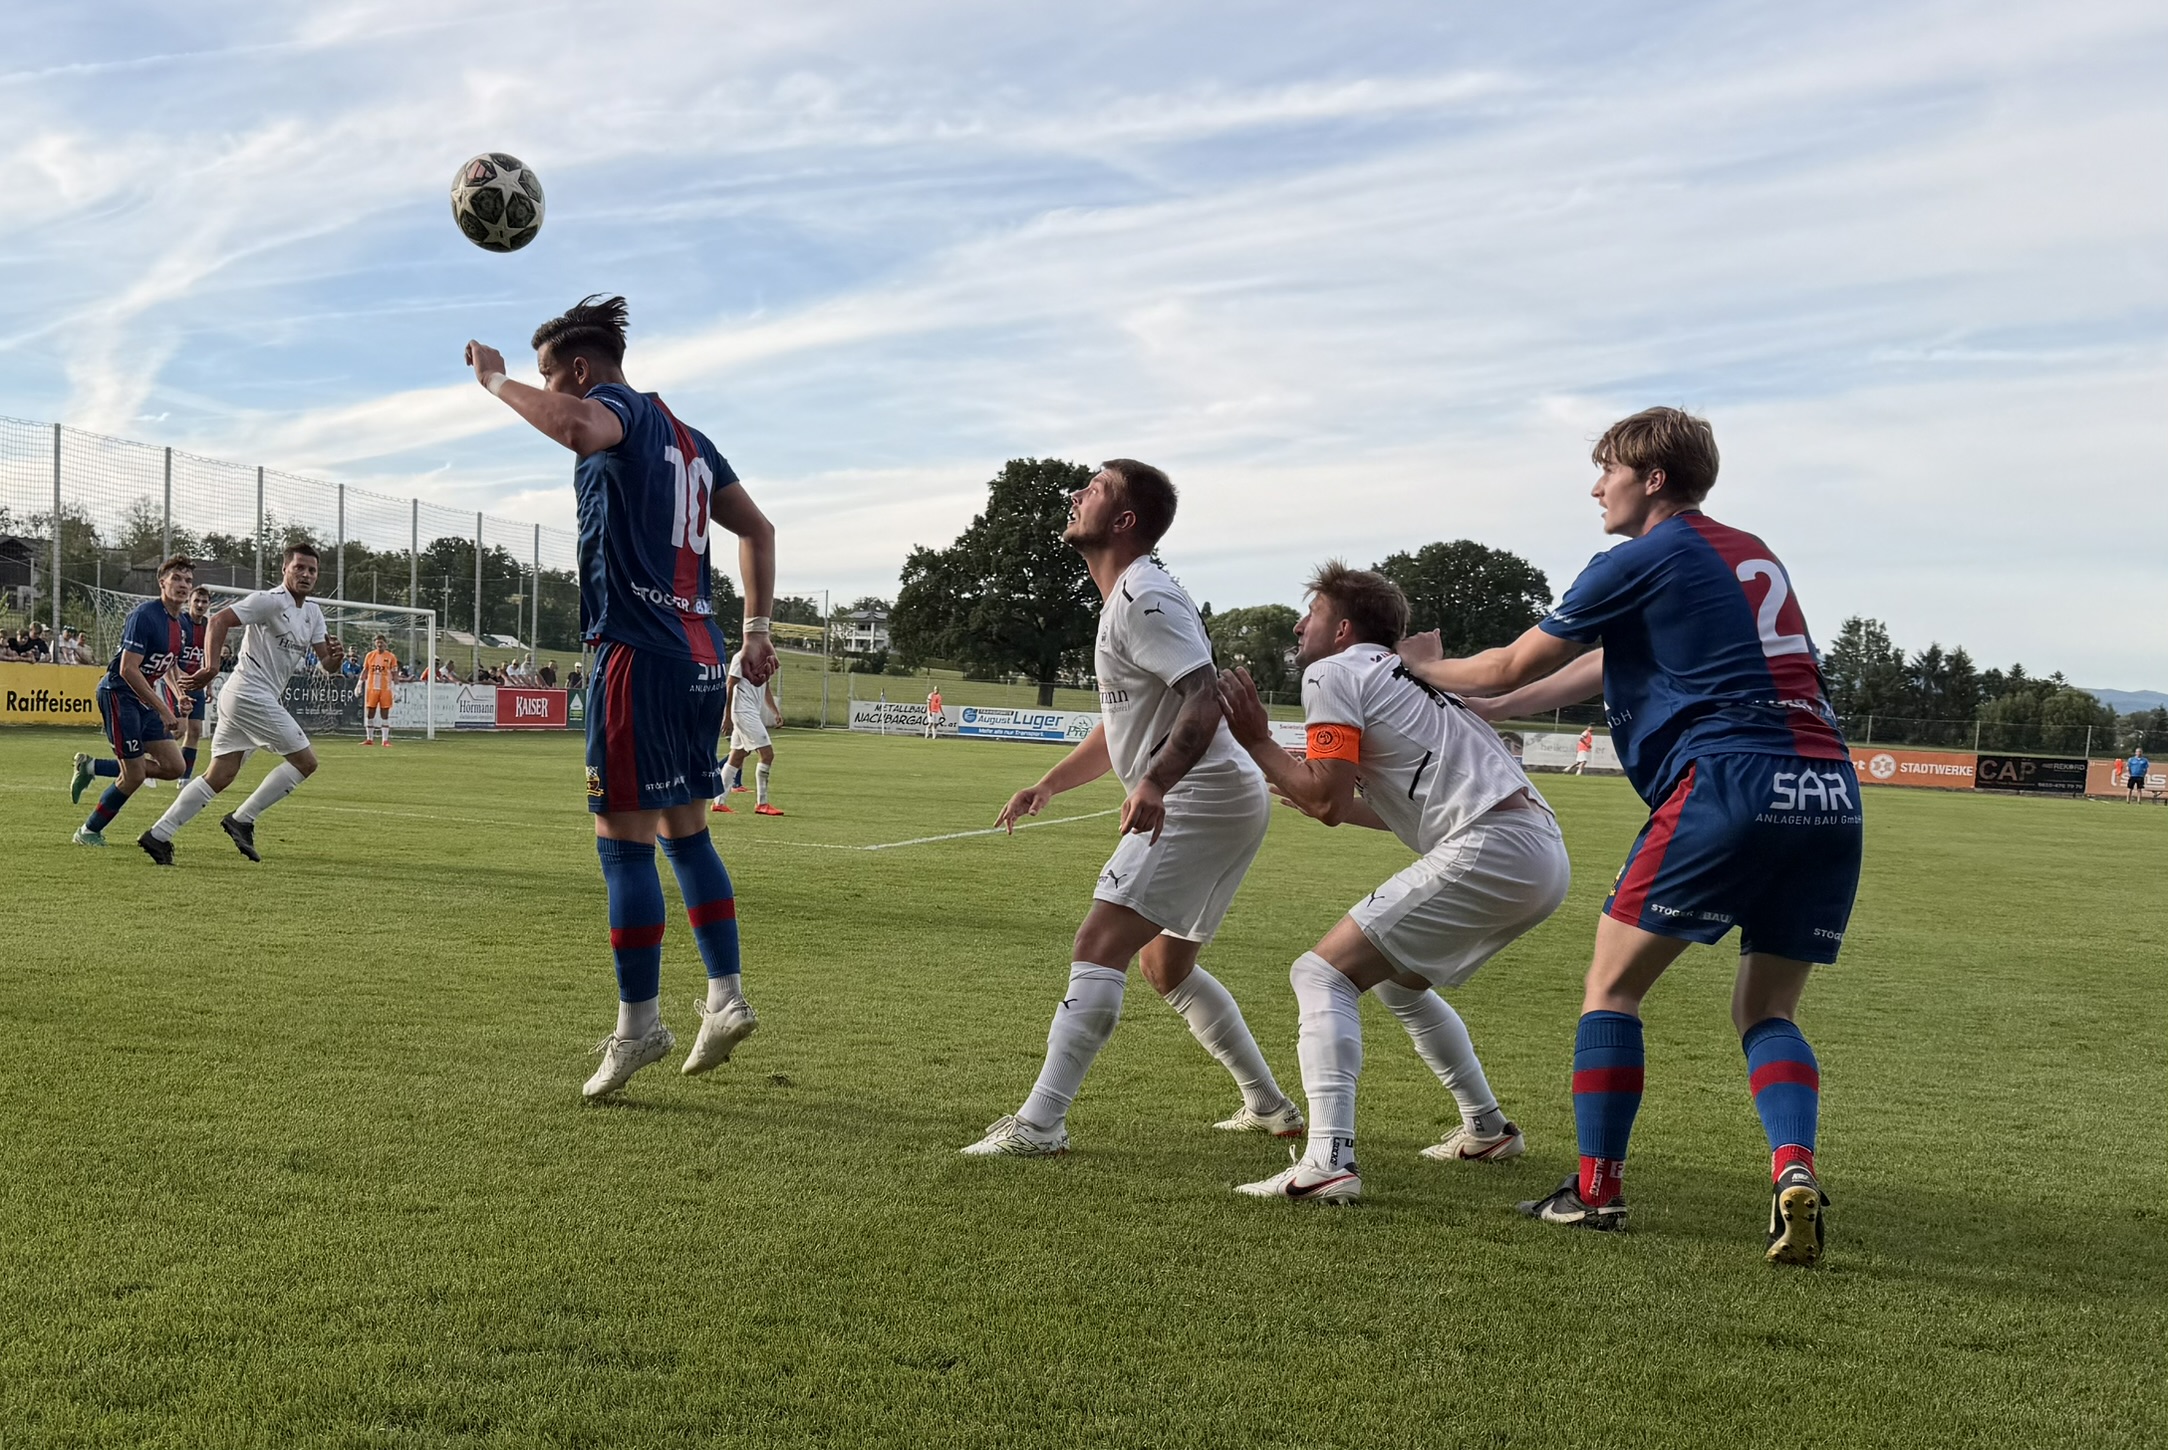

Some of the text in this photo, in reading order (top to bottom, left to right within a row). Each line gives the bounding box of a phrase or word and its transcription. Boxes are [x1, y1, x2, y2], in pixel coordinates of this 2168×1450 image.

[664, 445, 714, 556] 10
[1735, 558, 1809, 658] 2
[6, 690, 92, 713] Raiffeisen
[285, 687, 354, 704] SCHNEIDER
[459, 700, 495, 714] Hörmann
[515, 696, 548, 717] KAISER
[978, 711, 1064, 729] August Luger
[126, 739, 140, 753] 12
[1900, 762, 1974, 777] STADTWERKE
[2053, 763, 2085, 771] REKORD
[1769, 767, 1854, 811] SAR
[1755, 813, 1811, 825] ANLAGEN
[1814, 816, 1838, 825] BAU
